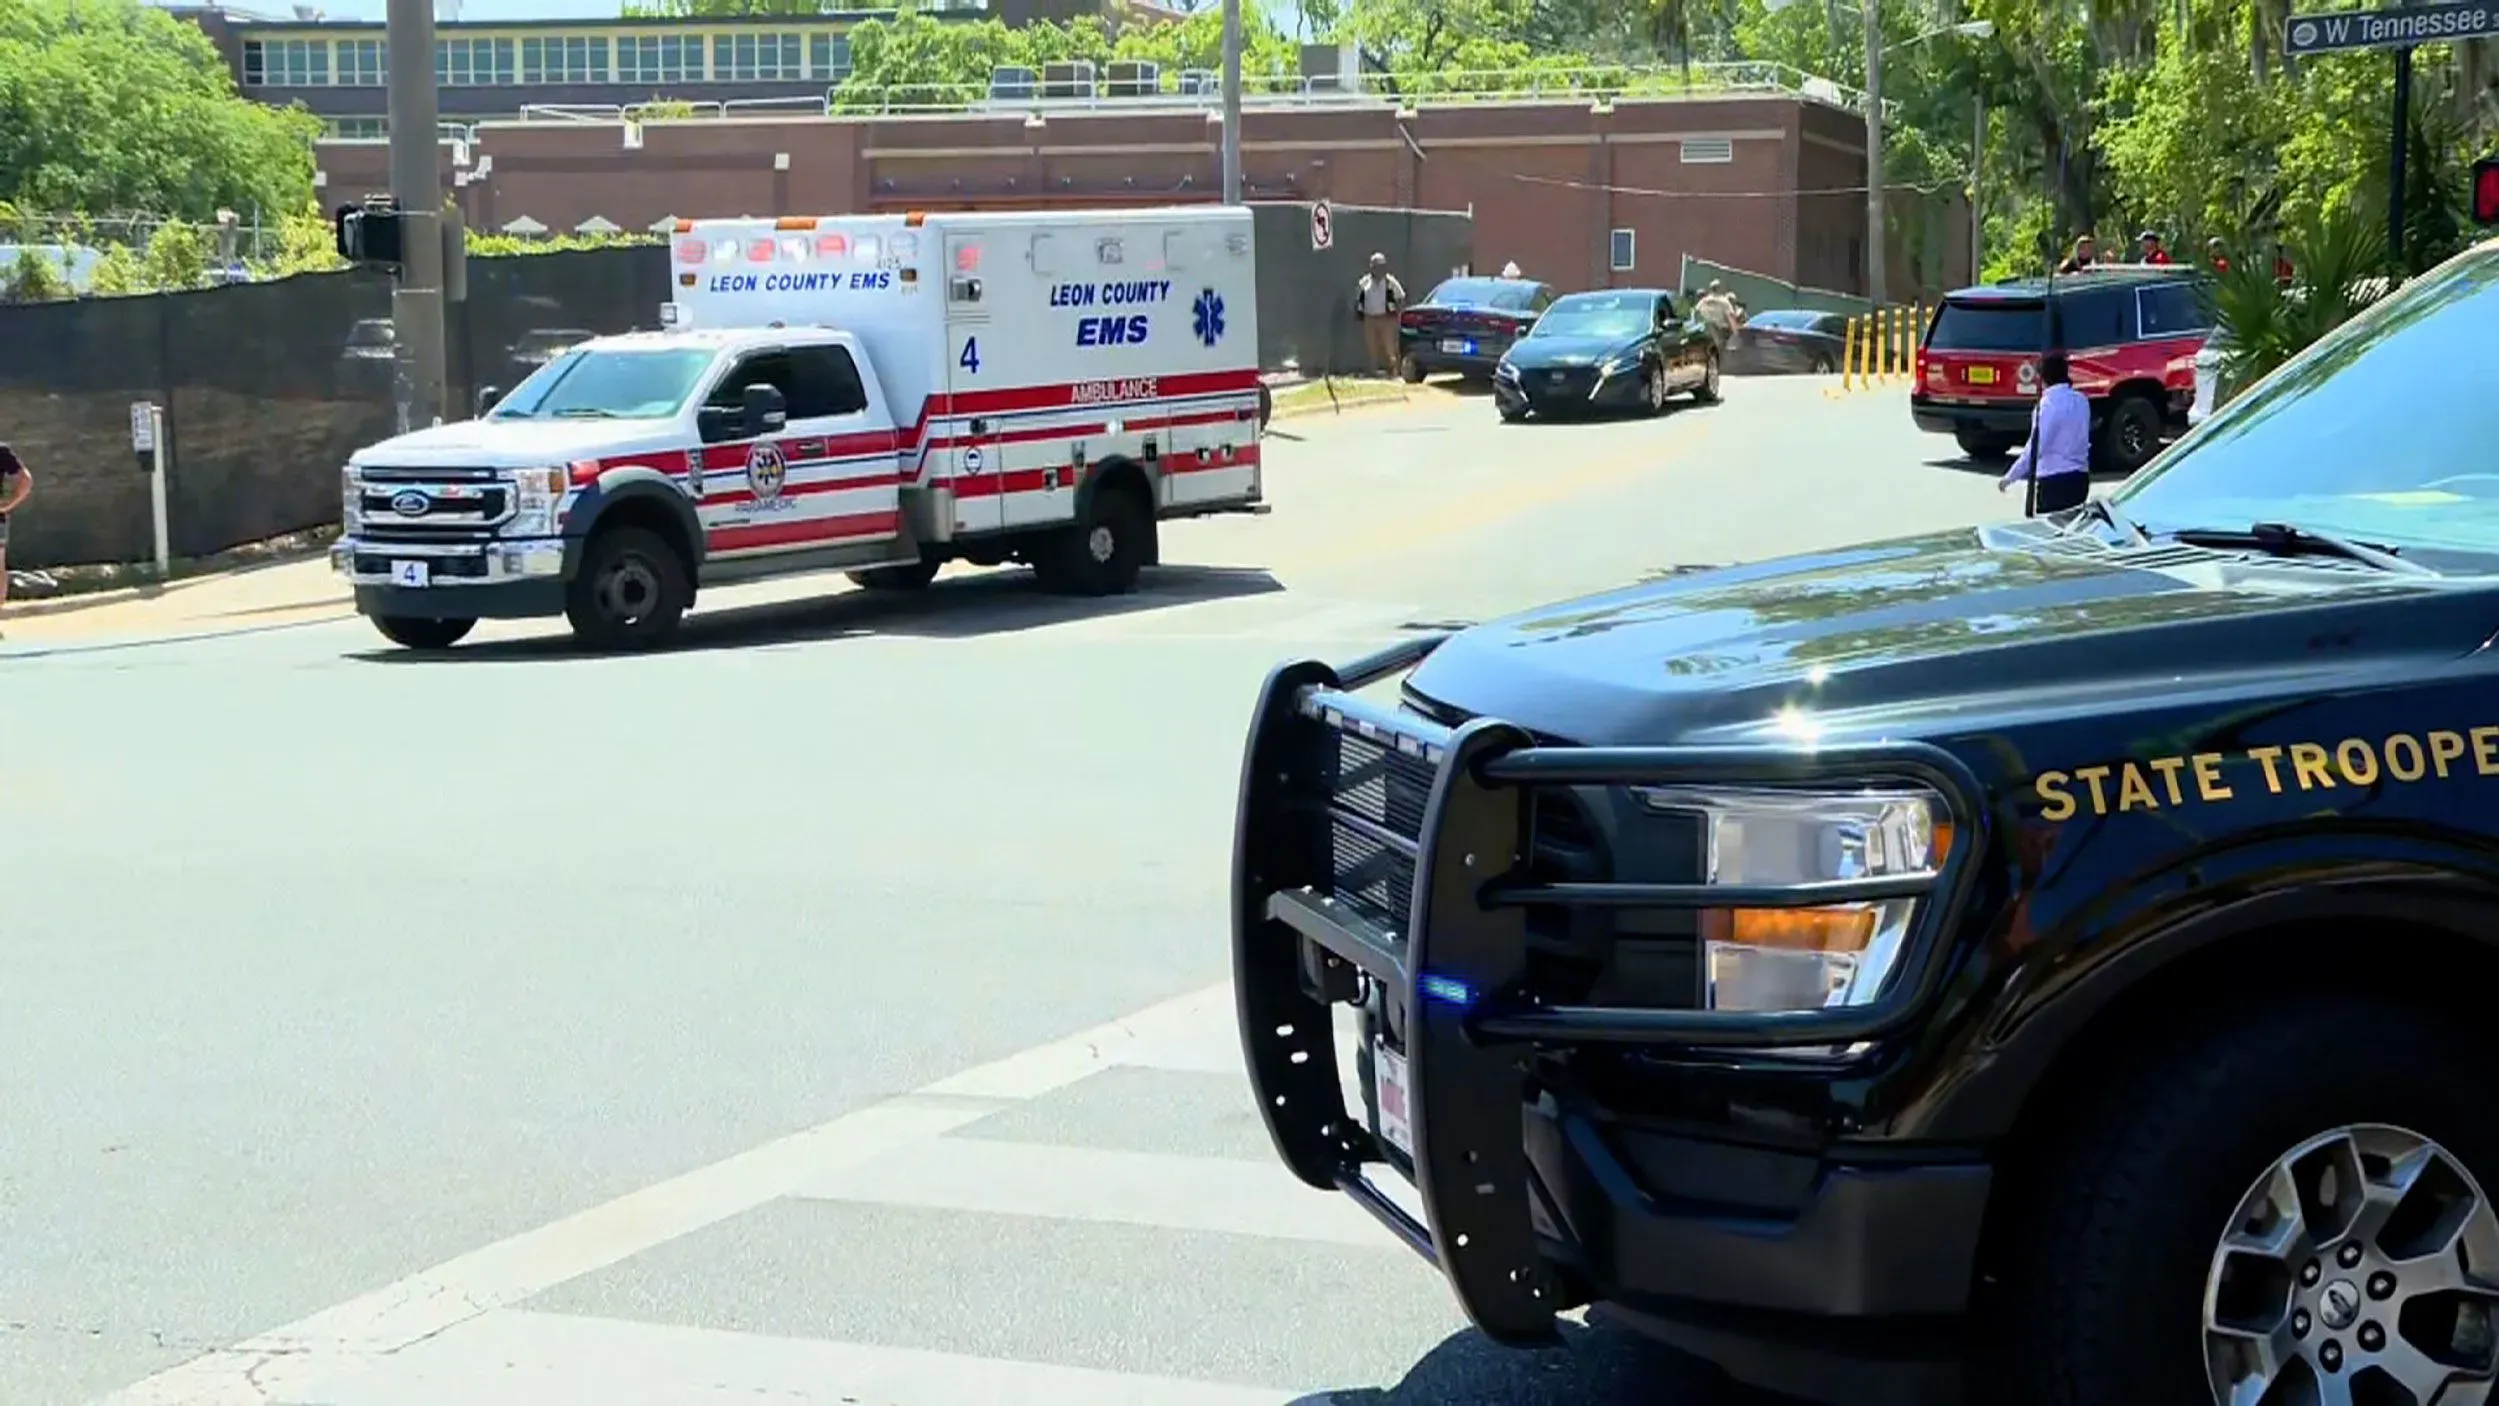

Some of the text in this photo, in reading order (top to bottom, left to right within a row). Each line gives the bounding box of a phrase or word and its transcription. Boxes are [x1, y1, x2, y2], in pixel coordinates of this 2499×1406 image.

[2325, 18, 2349, 43] W
[2358, 9, 2486, 40] Tennessee
[710, 271, 890, 292] LEON COUNTY EMS
[1050, 280, 1170, 307] LEON COUNTY
[1076, 315, 1148, 346] EMS
[960, 336, 980, 374] 4
[1071, 378, 1157, 404] AMBULANCE
[404, 563, 417, 582] 4
[2035, 726, 2499, 822] STATE TROOPE
